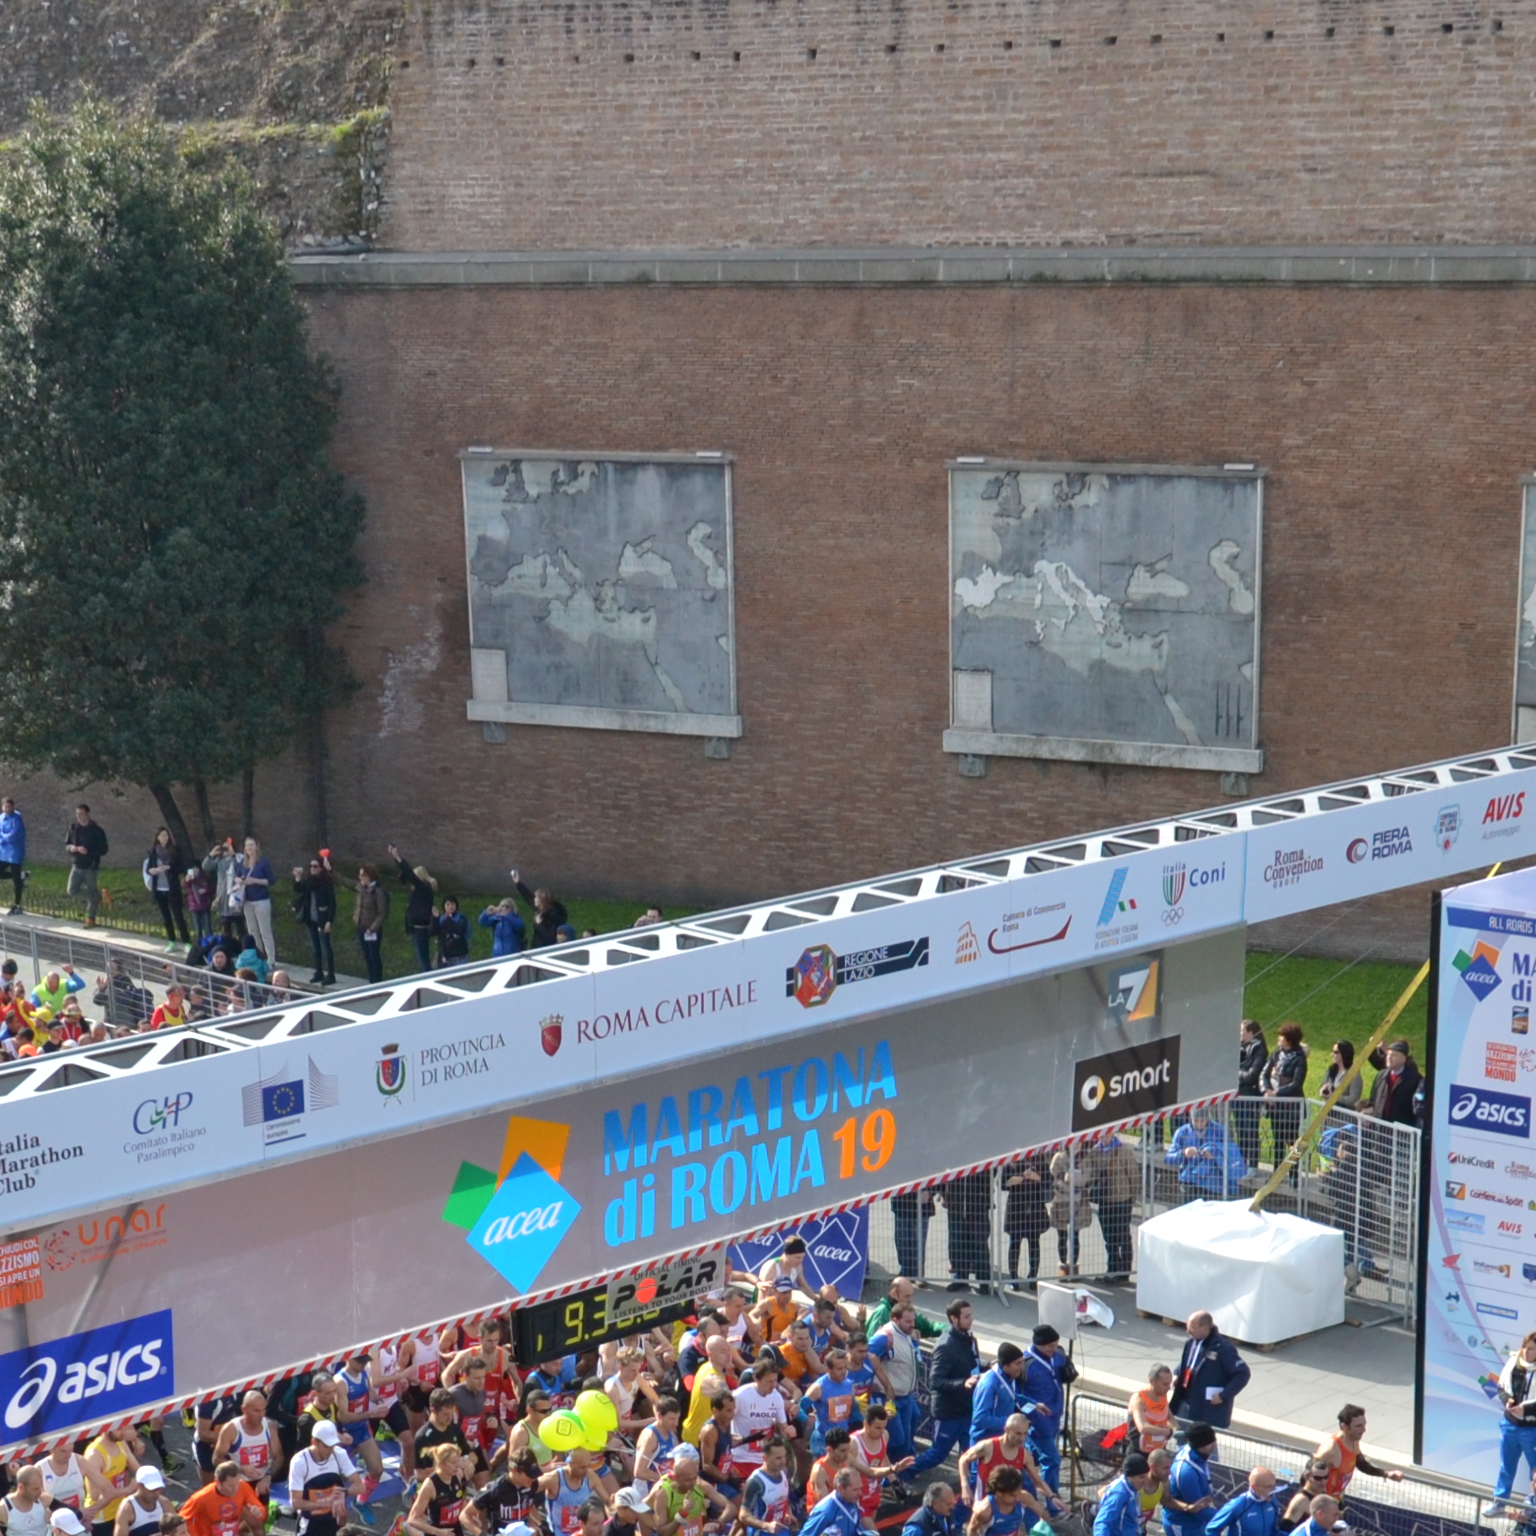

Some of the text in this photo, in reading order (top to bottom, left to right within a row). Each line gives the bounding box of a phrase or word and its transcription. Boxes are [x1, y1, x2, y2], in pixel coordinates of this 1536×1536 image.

[1482, 791, 1526, 824] AVIS
[1372, 826, 1410, 846] FIERA
[1274, 849, 1305, 865] Roma
[1371, 840, 1413, 861] ROMA
[1163, 862, 1186, 874] Italia
[1188, 861, 1226, 887] Coni
[1264, 855, 1324, 884] Convention
[1273, 877, 1301, 889] GROUP
[1489, 916, 1503, 929] ALL
[1506, 919, 1533, 934] ROADS
[843, 946, 889, 968] REGIONE
[843, 965, 875, 982] LAZIO
[1465, 969, 1496, 985] acea
[1511, 979, 1532, 1002] di
[577, 979, 758, 1044] ROMA CAPITALE
[420, 1033, 506, 1066] PROVINCIA
[420, 1058, 490, 1086] DI ROMA
[1109, 1059, 1171, 1098] smart
[1485, 1066, 1516, 1082] MONDO
[604, 1042, 897, 1176] MARATONA
[1475, 1100, 1526, 1127] asics
[124, 1127, 206, 1154] Comitato Italiano
[136, 1142, 195, 1164] Paralimpico
[1458, 1153, 1495, 1170] UniCredit
[605, 1108, 896, 1247] di ROMA 19
[78, 1204, 166, 1245] unar
[483, 1201, 563, 1246] acea
[1497, 1220, 1522, 1234] AVIS
[23, 1237, 38, 1249] COL
[814, 1240, 852, 1262] acea
[8, 1271, 28, 1285] APRE
[29, 1267, 41, 1278] UN
[634, 1256, 701, 1281] OFFICIAL TIMING
[613, 1260, 717, 1311] POLAR
[614, 1284, 713, 1319] LISTENS TO YOUR BODY
[58, 1339, 162, 1404] asics
[750, 1411, 776, 1420] PAOLO
